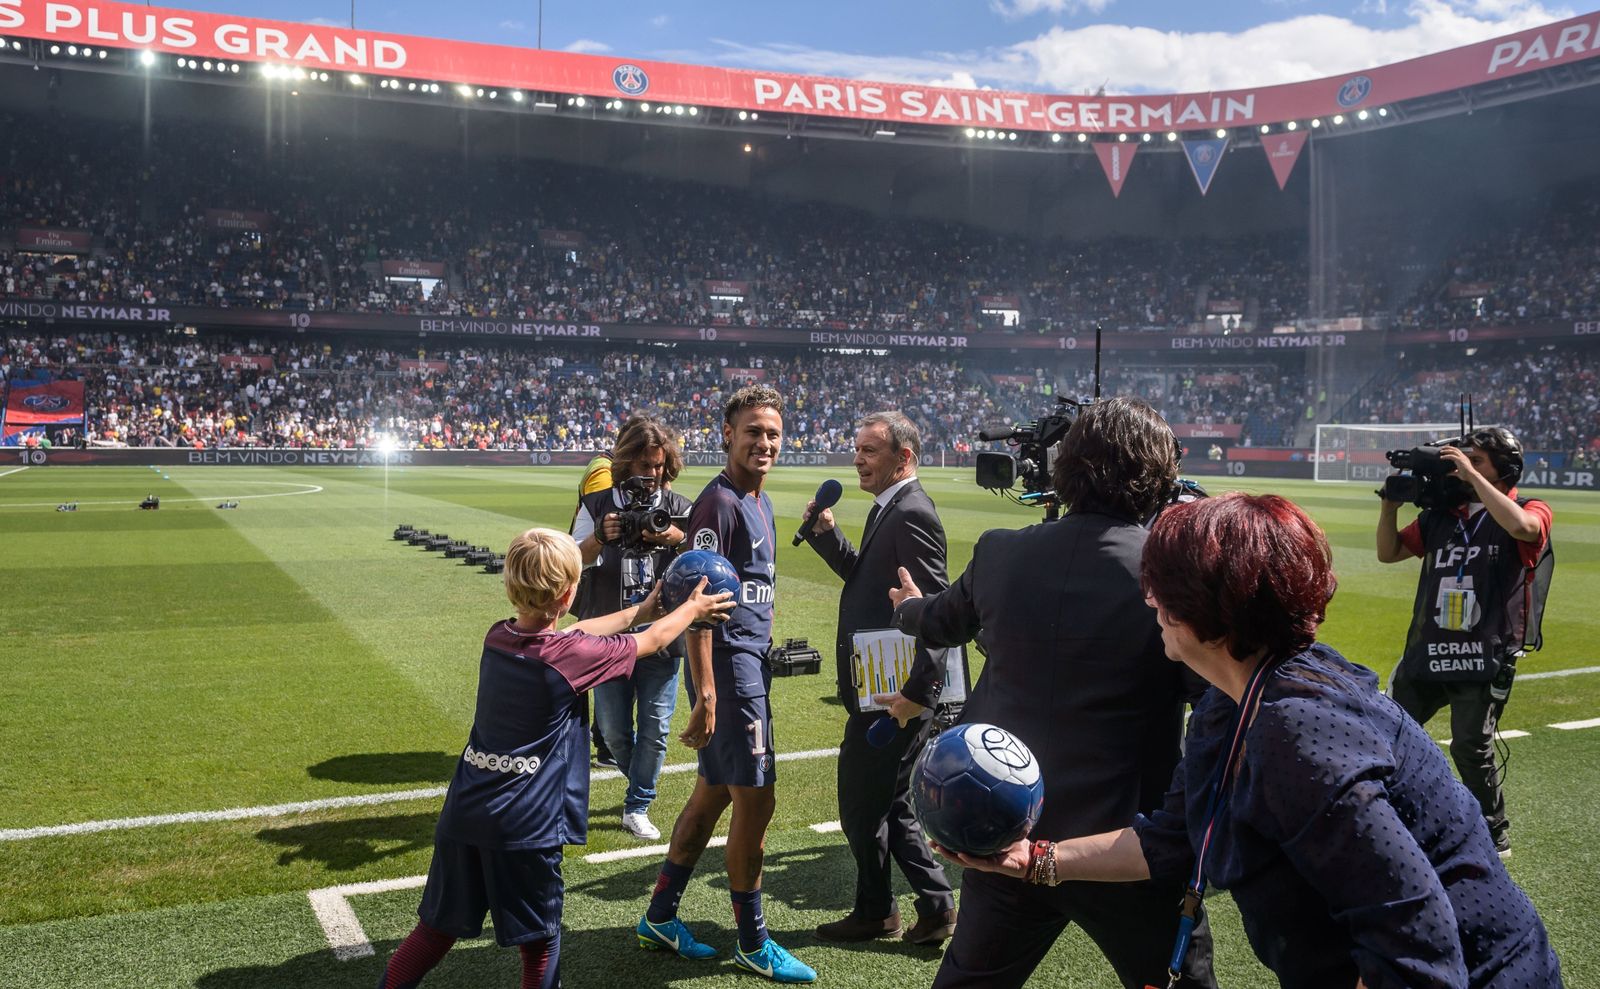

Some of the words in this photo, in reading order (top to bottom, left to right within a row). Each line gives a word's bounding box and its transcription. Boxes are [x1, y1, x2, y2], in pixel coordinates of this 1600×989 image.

[45, 2, 197, 48] PLUS
[213, 24, 407, 69] GRAND
[753, 77, 887, 113] PARIS
[901, 90, 1255, 128] SAINT-GERMAIN
[217, 218, 259, 229] Emirates
[35, 236, 72, 247] Emirates
[48, 231, 60, 240] Fly
[398, 267, 431, 275] Emirates
[61, 305, 142, 321] NEYMAR
[146, 308, 171, 322] JR
[289, 312, 311, 328] 10
[420, 319, 508, 335] BEM-VINDO
[511, 323, 578, 337] NEYMAR
[580, 325, 601, 337] JR
[698, 327, 717, 341] 10
[1448, 327, 1469, 342] 10
[1573, 321, 1600, 335] BE
[810, 332, 886, 345] BEM-VINDO
[889, 335, 947, 348] NEYMAR
[949, 336, 968, 348] JR
[1058, 337, 1077, 350] 10
[1171, 337, 1254, 349] BEM-VINDO
[1257, 334, 1323, 349] NEYMAR
[1325, 334, 1346, 347] JR
[18, 449, 47, 465] 10
[188, 451, 299, 465] BEM-VINDO
[529, 452, 551, 465] 10
[802, 454, 828, 466] JR
[1226, 461, 1246, 476] 10
[1562, 471, 1595, 487] JR
[1434, 545, 1482, 569] LFP
[1427, 641, 1483, 656] ECRAN
[1429, 658, 1485, 673] GEANT
